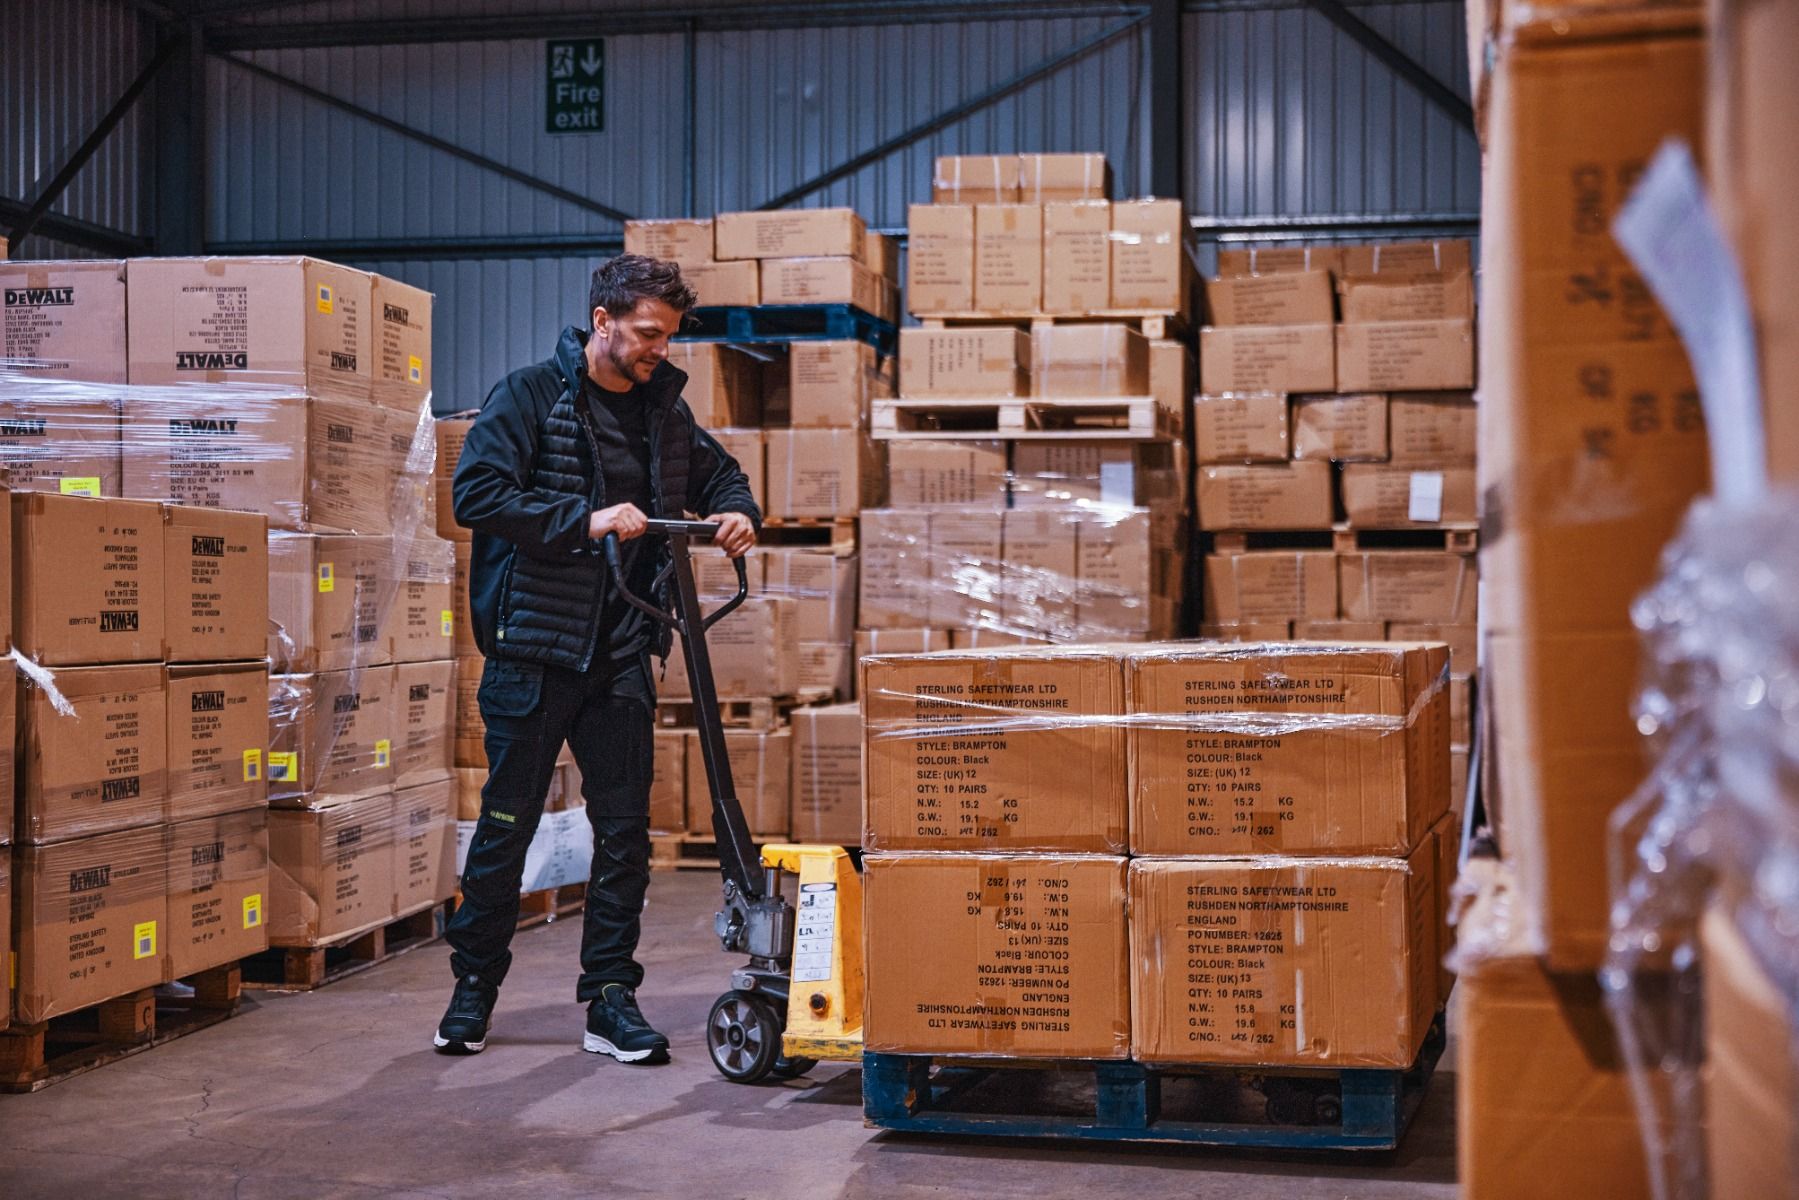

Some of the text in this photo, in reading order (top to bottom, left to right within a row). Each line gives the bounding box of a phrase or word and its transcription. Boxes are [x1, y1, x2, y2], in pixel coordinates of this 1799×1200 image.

[555, 83, 601, 105] Fire
[555, 105, 599, 128] exit
[192, 536, 224, 556] DEWALT
[100, 611, 138, 632] DEWALT
[916, 685, 1057, 694] STERLING SAFETYWEAR LTD
[1185, 681, 1235, 690] STERLING
[1315, 680, 1334, 689] LTD
[1186, 694, 1345, 704] RUSHDEN NORTHAMPTONSHIRE
[963, 699, 1068, 709] NORTHAMPTONSHIRE
[917, 741, 1006, 751] STYLE: BRAMPTON
[1187, 739, 1280, 748] STYLE: BRAMPTON
[917, 756, 989, 765] COLOUR: Black
[1187, 753, 1262, 763] COLOUR: Black
[917, 770, 976, 781] SIZE: (UK) 12
[1187, 768, 1250, 779] SIZE: (UK) 12
[917, 785, 939, 794] QTY:
[959, 785, 987, 793] PAIRS
[1188, 783, 1261, 792] QTY: 10 PAIRS
[1003, 800, 1018, 808] KG
[1188, 797, 1293, 806] N.W.: 15.2 KG
[918, 814, 1018, 823] G.W.: 19.1 KG
[1188, 812, 1294, 821] G.W.: 19.1 KG
[918, 827, 947, 836] C/NO.:
[1189, 827, 1220, 835] C/NO.:
[1257, 827, 1274, 835] 262
[987, 878, 1003, 886] 262
[1038, 879, 1068, 888] C/NO.:
[1187, 887, 1336, 896] STERLING SAFETYWEAR LTD
[967, 892, 1068, 902] G.W.: 19.6 KG
[968, 906, 1068, 916] N.W.: 15.8 KG
[1188, 902, 1349, 911] RUSHDEN NORTHAMPTONSHIRE
[1188, 916, 1236, 925] ENGLAND
[998, 922, 1068, 930] QTY: 10 PAIRS
[1188, 931, 1282, 940] PO NUMBER: 12625
[1009, 936, 1068, 945] SIZE: (UK) 13
[1188, 945, 1283, 954] STYLE: BRAMPTON
[995, 950, 1068, 959] COLOUR: Black
[978, 965, 1069, 973] STYLE: BRAMPTON
[1188, 960, 1265, 969] COLOUR: Black
[979, 978, 1069, 988] PO NUMBER: 12625
[1188, 974, 1251, 985] SIZE: (UK) 13
[1023, 994, 1069, 1002] ENGLAND
[1188, 989, 1262, 999] QTY: 10 PAIRS
[917, 1004, 1069, 1017] RUSHDEN NORTHAMPTONSHIRE
[1189, 1004, 1295, 1014] N.W.: 15.8 KG
[928, 1018, 1070, 1031] STERLING SAFETYWEAR LTD
[1189, 1018, 1296, 1029] G.W.: 19.6 KG
[1189, 1033, 1221, 1042] C/NO.:
[1257, 1035, 1274, 1043] 262
